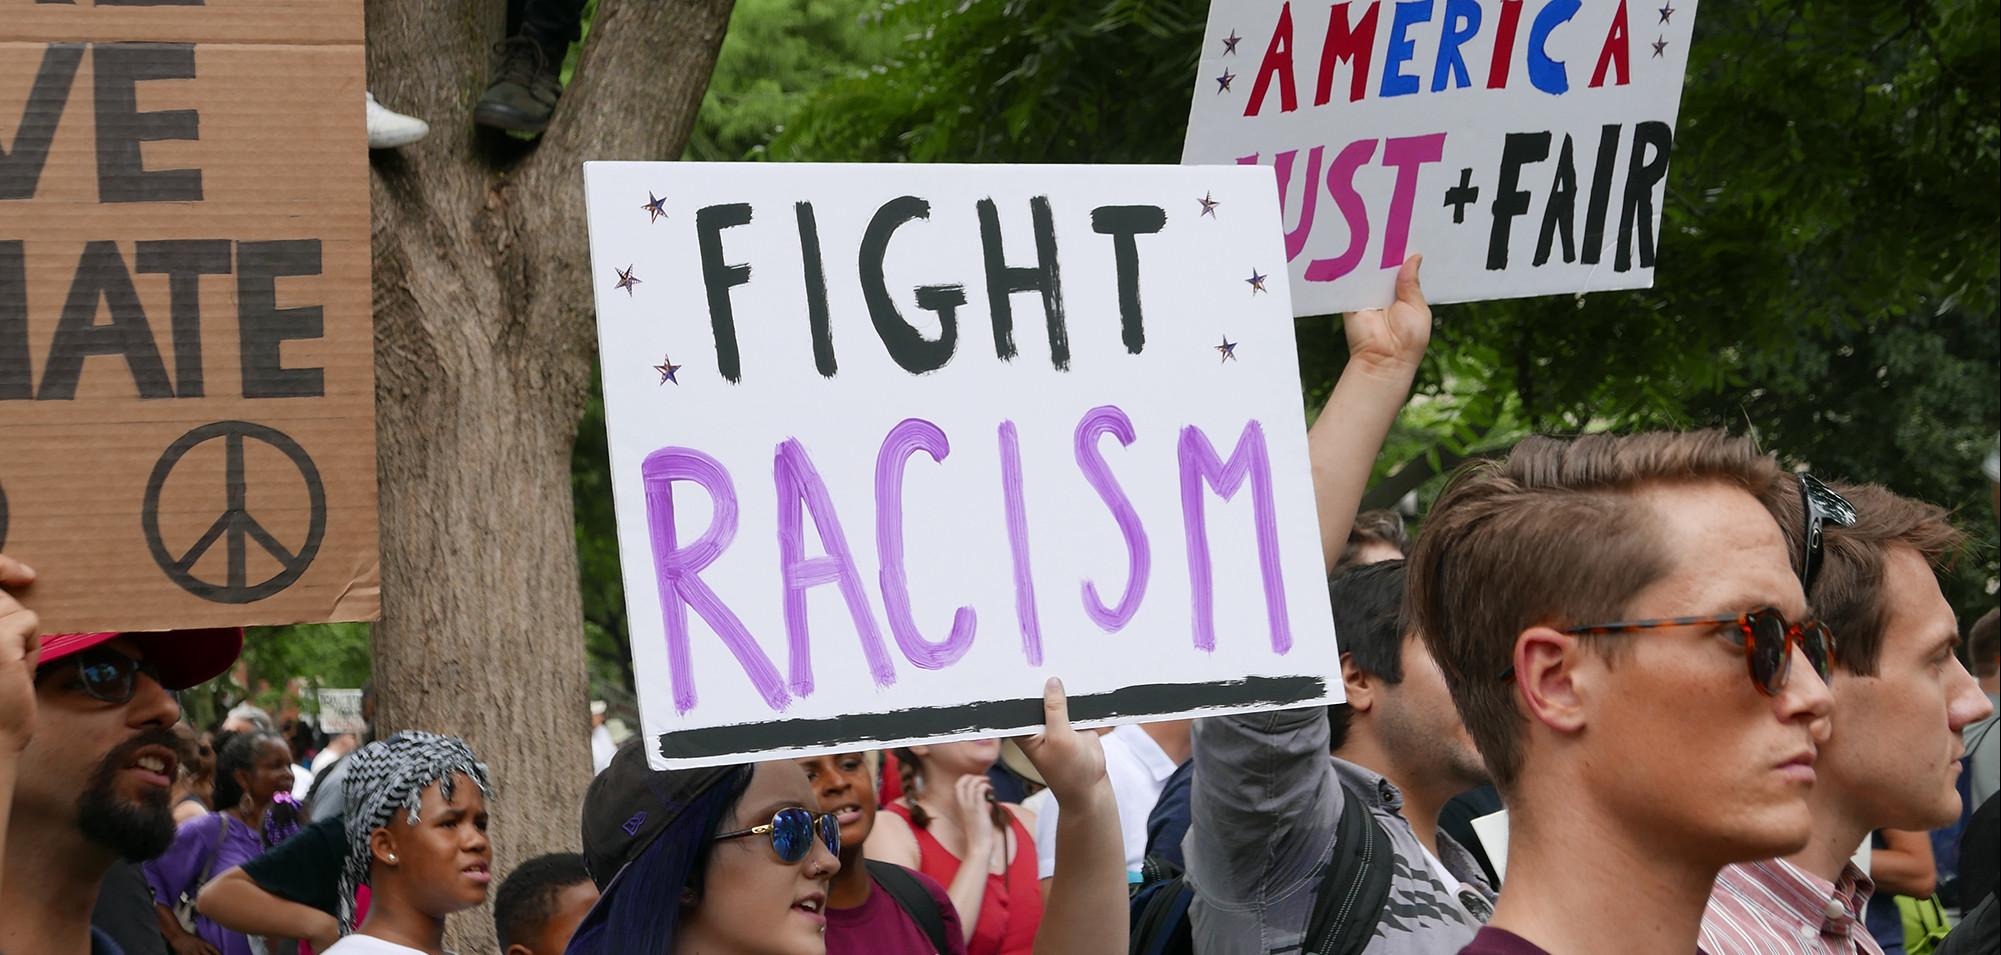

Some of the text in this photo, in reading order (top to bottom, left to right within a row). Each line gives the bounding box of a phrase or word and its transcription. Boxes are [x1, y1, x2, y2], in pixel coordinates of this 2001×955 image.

[1243, 0, 1631, 117] AMERICA
[1235, 132, 1448, 282] UST
[1486, 120, 1672, 272] FAIR
[696, 195, 1168, 385] FIGHT
[641, 404, 1294, 717] RACISM
